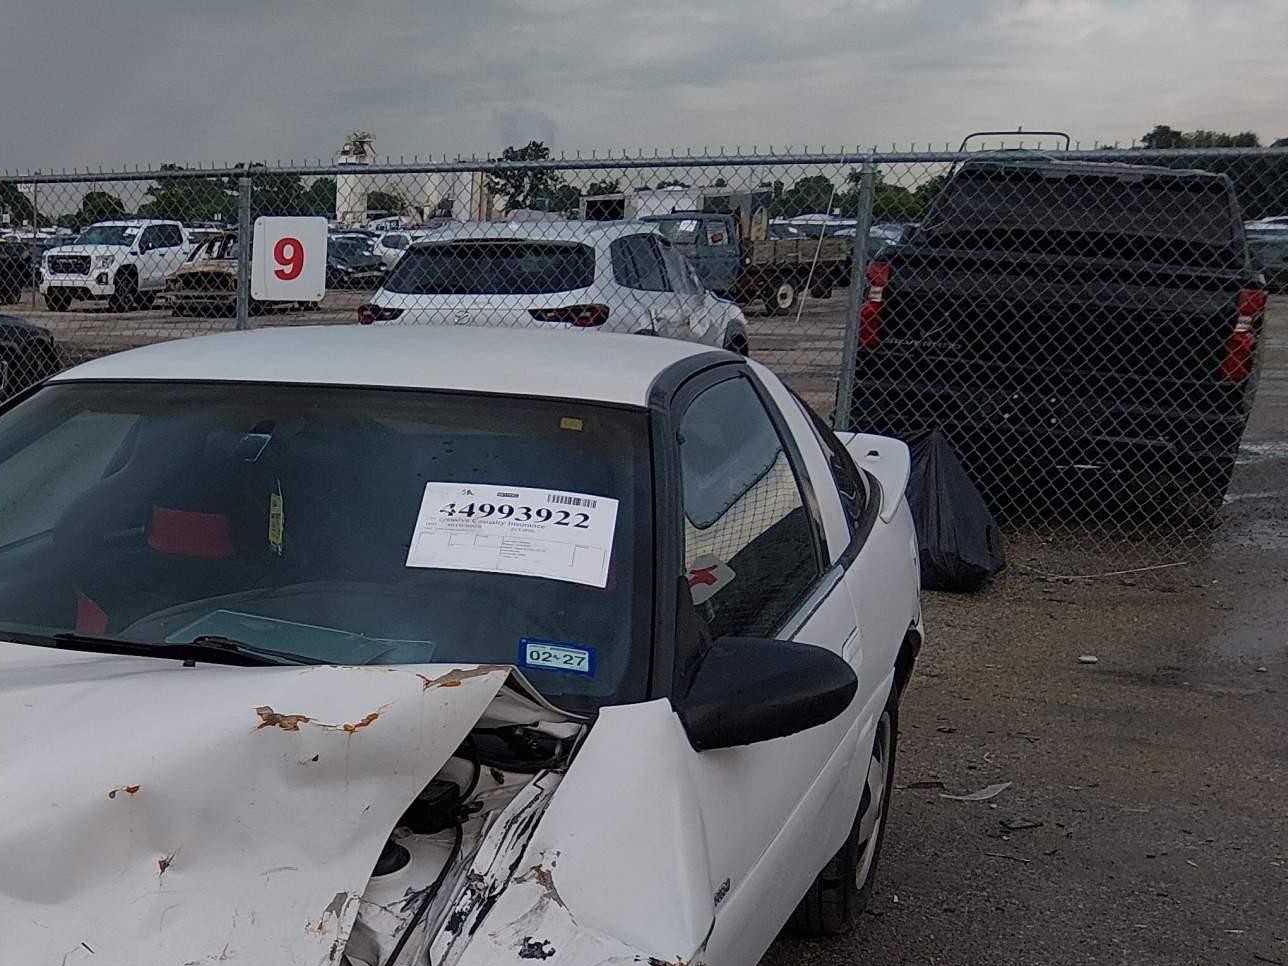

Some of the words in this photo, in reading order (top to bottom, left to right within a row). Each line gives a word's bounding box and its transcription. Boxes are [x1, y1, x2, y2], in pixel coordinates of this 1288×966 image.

[274, 237, 304, 281] 9
[439, 501, 590, 529] 44993922
[529, 650, 552, 662] 02
[563, 654, 586, 666] 27
